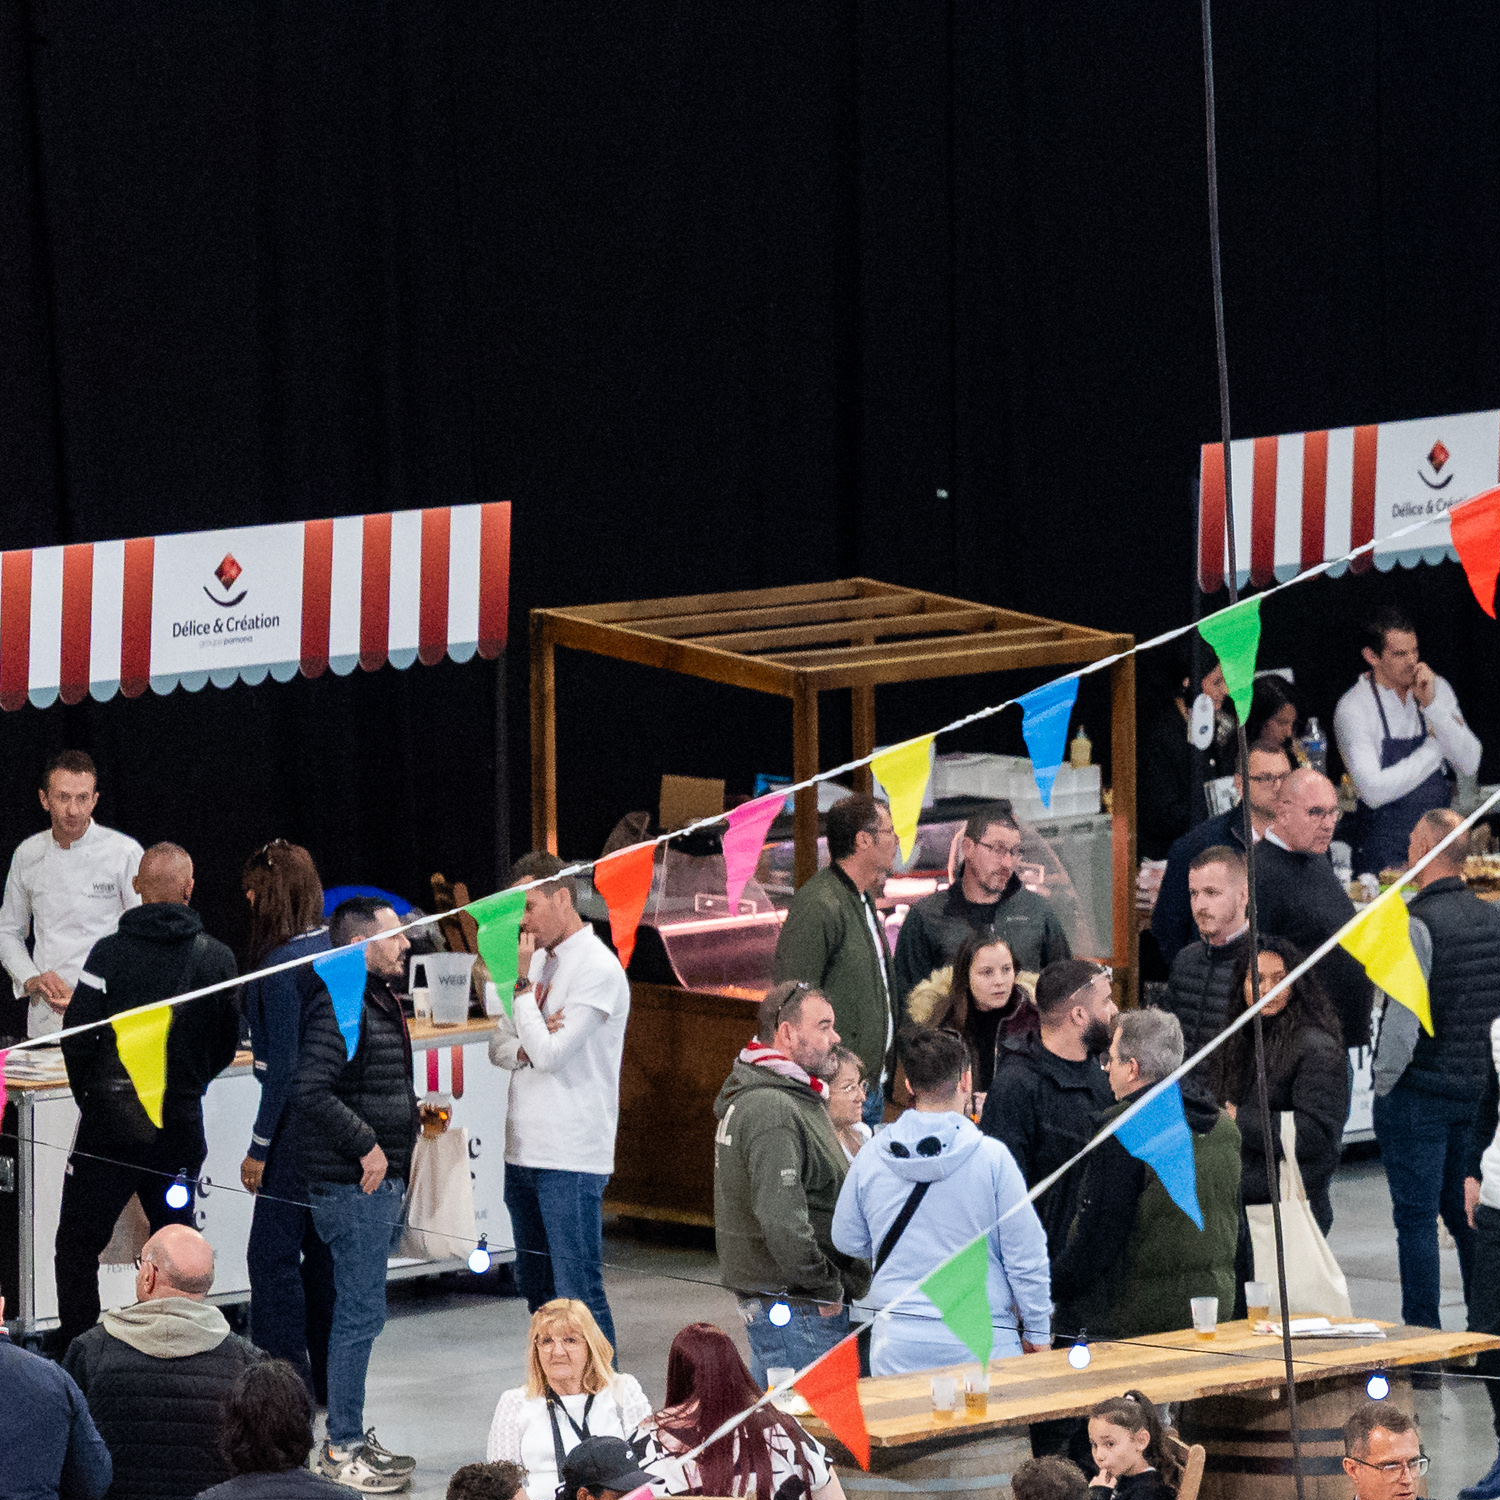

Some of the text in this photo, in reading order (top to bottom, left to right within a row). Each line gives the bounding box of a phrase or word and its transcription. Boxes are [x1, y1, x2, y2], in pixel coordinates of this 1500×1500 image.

[172, 614, 280, 638] Délice & Création
[223, 634, 253, 645] pomona
